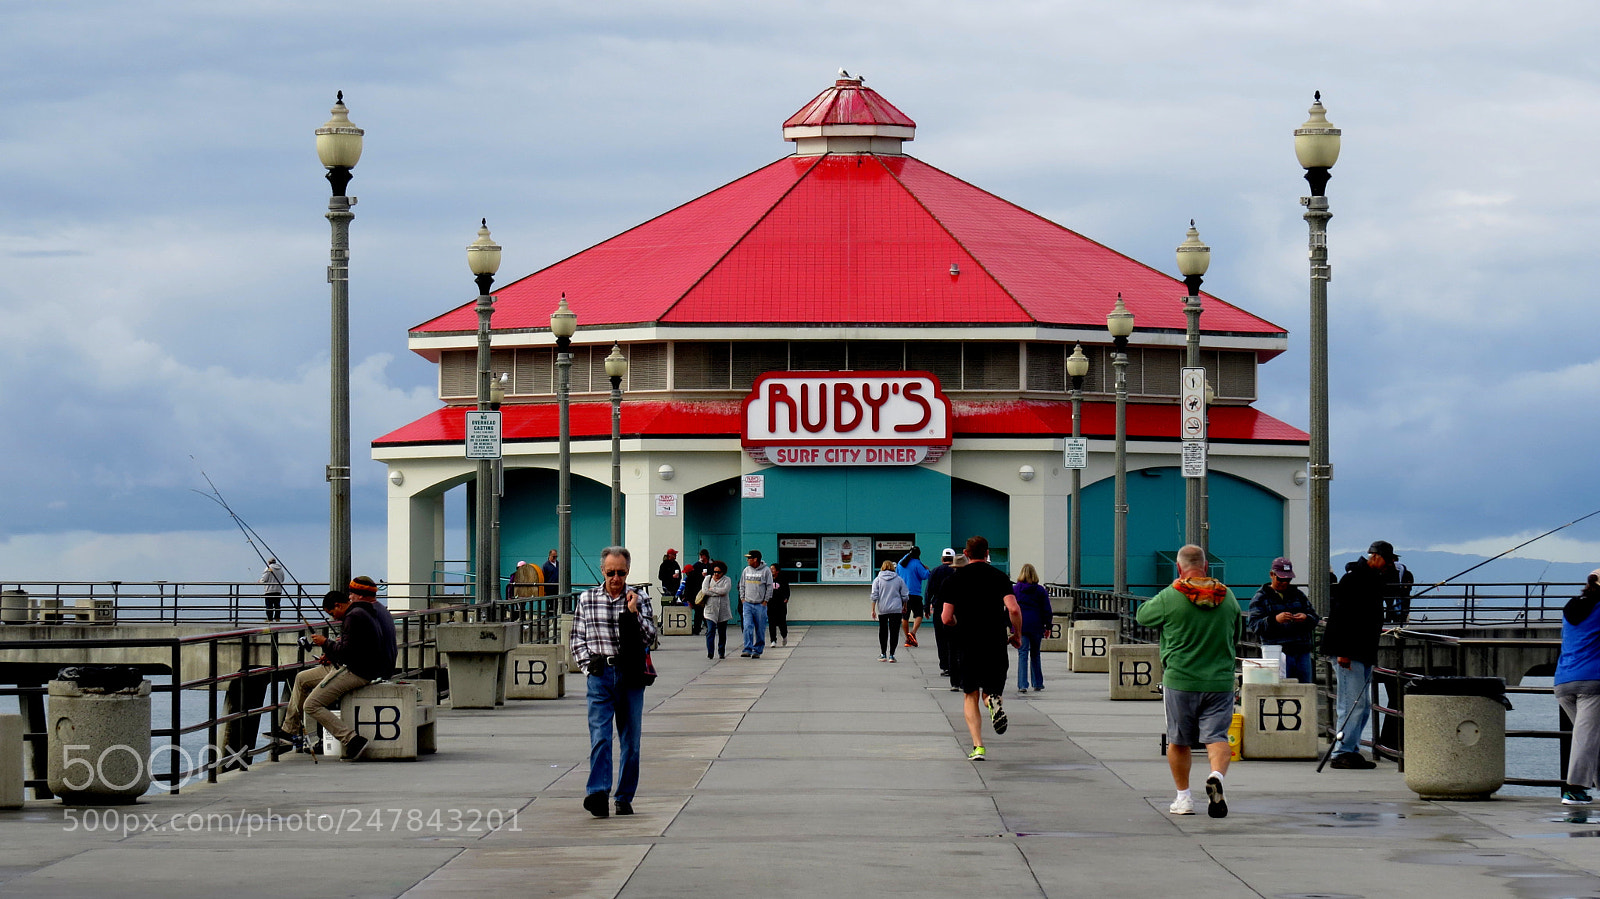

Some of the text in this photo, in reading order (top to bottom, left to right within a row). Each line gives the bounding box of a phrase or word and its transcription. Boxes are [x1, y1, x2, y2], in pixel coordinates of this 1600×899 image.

[768, 382, 932, 433] RUBY'S
[776, 448, 917, 463] SURF CITY DINER
[668, 613, 687, 628] HB
[1081, 637, 1106, 657] HB
[514, 660, 548, 686] HB
[1119, 661, 1152, 686] HB
[354, 705, 401, 741] HB
[1259, 698, 1302, 731] HB
